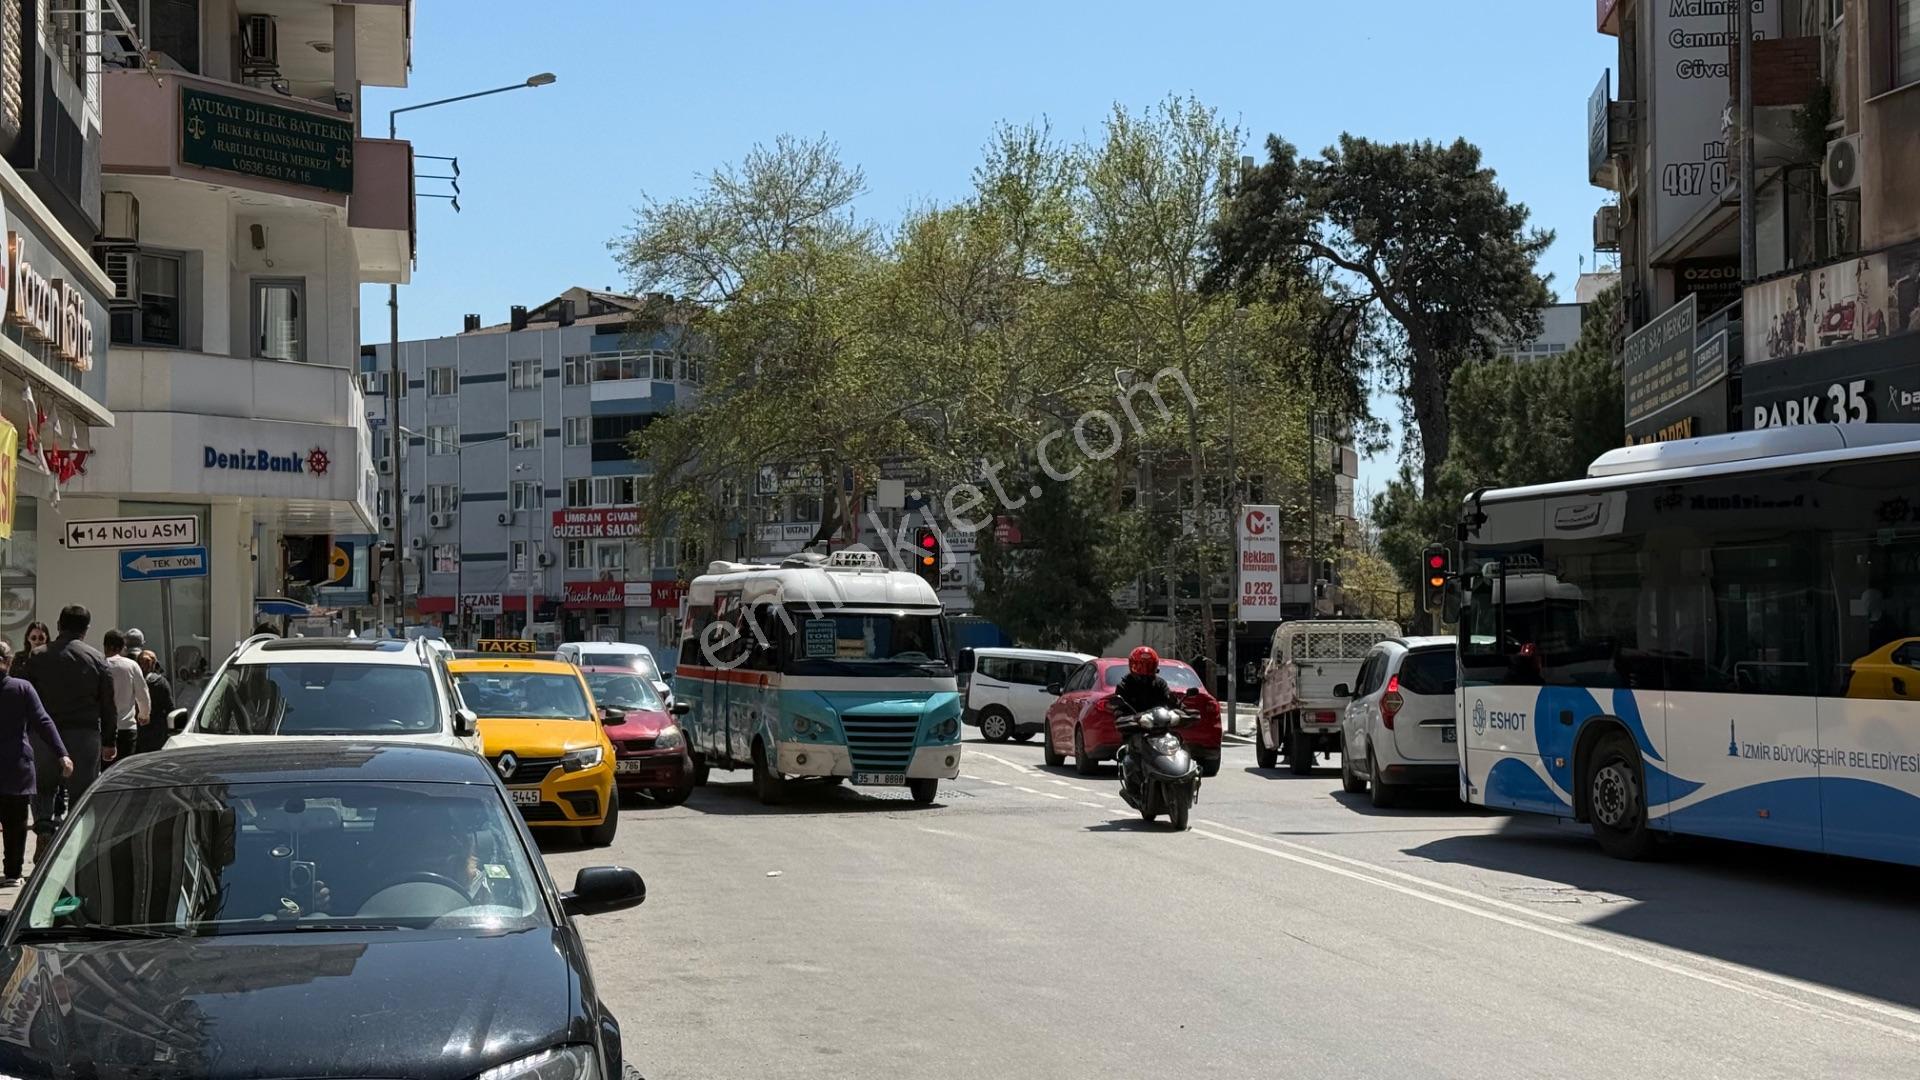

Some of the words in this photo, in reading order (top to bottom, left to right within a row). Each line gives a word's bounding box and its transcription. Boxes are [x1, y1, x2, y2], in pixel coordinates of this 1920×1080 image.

[1676, 59, 1729, 79] Güve
[188, 97, 242, 119] AVUKAT
[246, 108, 287, 130] DİLEK
[290, 118, 351, 141] BAYTEKİN
[217, 123, 252, 139] HUKUK
[253, 131, 261, 141] &
[263, 131, 326, 153] DANIŞMANLIK
[210, 139, 288, 163] ARABULUCULUK
[1663, 162, 1705, 196] 487
[1754, 396, 1819, 429] PARK
[1827, 380, 1868, 424] 35
[204, 446, 304, 473] DenizBank
[564, 511, 601, 522] ÜMRAN
[88, 527, 107, 541] 14
[152, 523, 187, 538] ASM
[153, 559, 170, 568] TEK
[176, 557, 196, 567] YÖN
[1243, 550, 1275, 563] Reklam
[1245, 582, 1251, 594] 0
[1254, 582, 1273, 594] 232
[1489, 711, 1527, 731] ESHOT
[1742, 741, 1771, 760] İZMİR
[1773, 744, 1847, 767] BÜYÜKŞEHİR
[1849, 750, 1920, 773] BELEDİYESİ
[859, 774, 868, 783] 35
[512, 792, 538, 803] 5445
